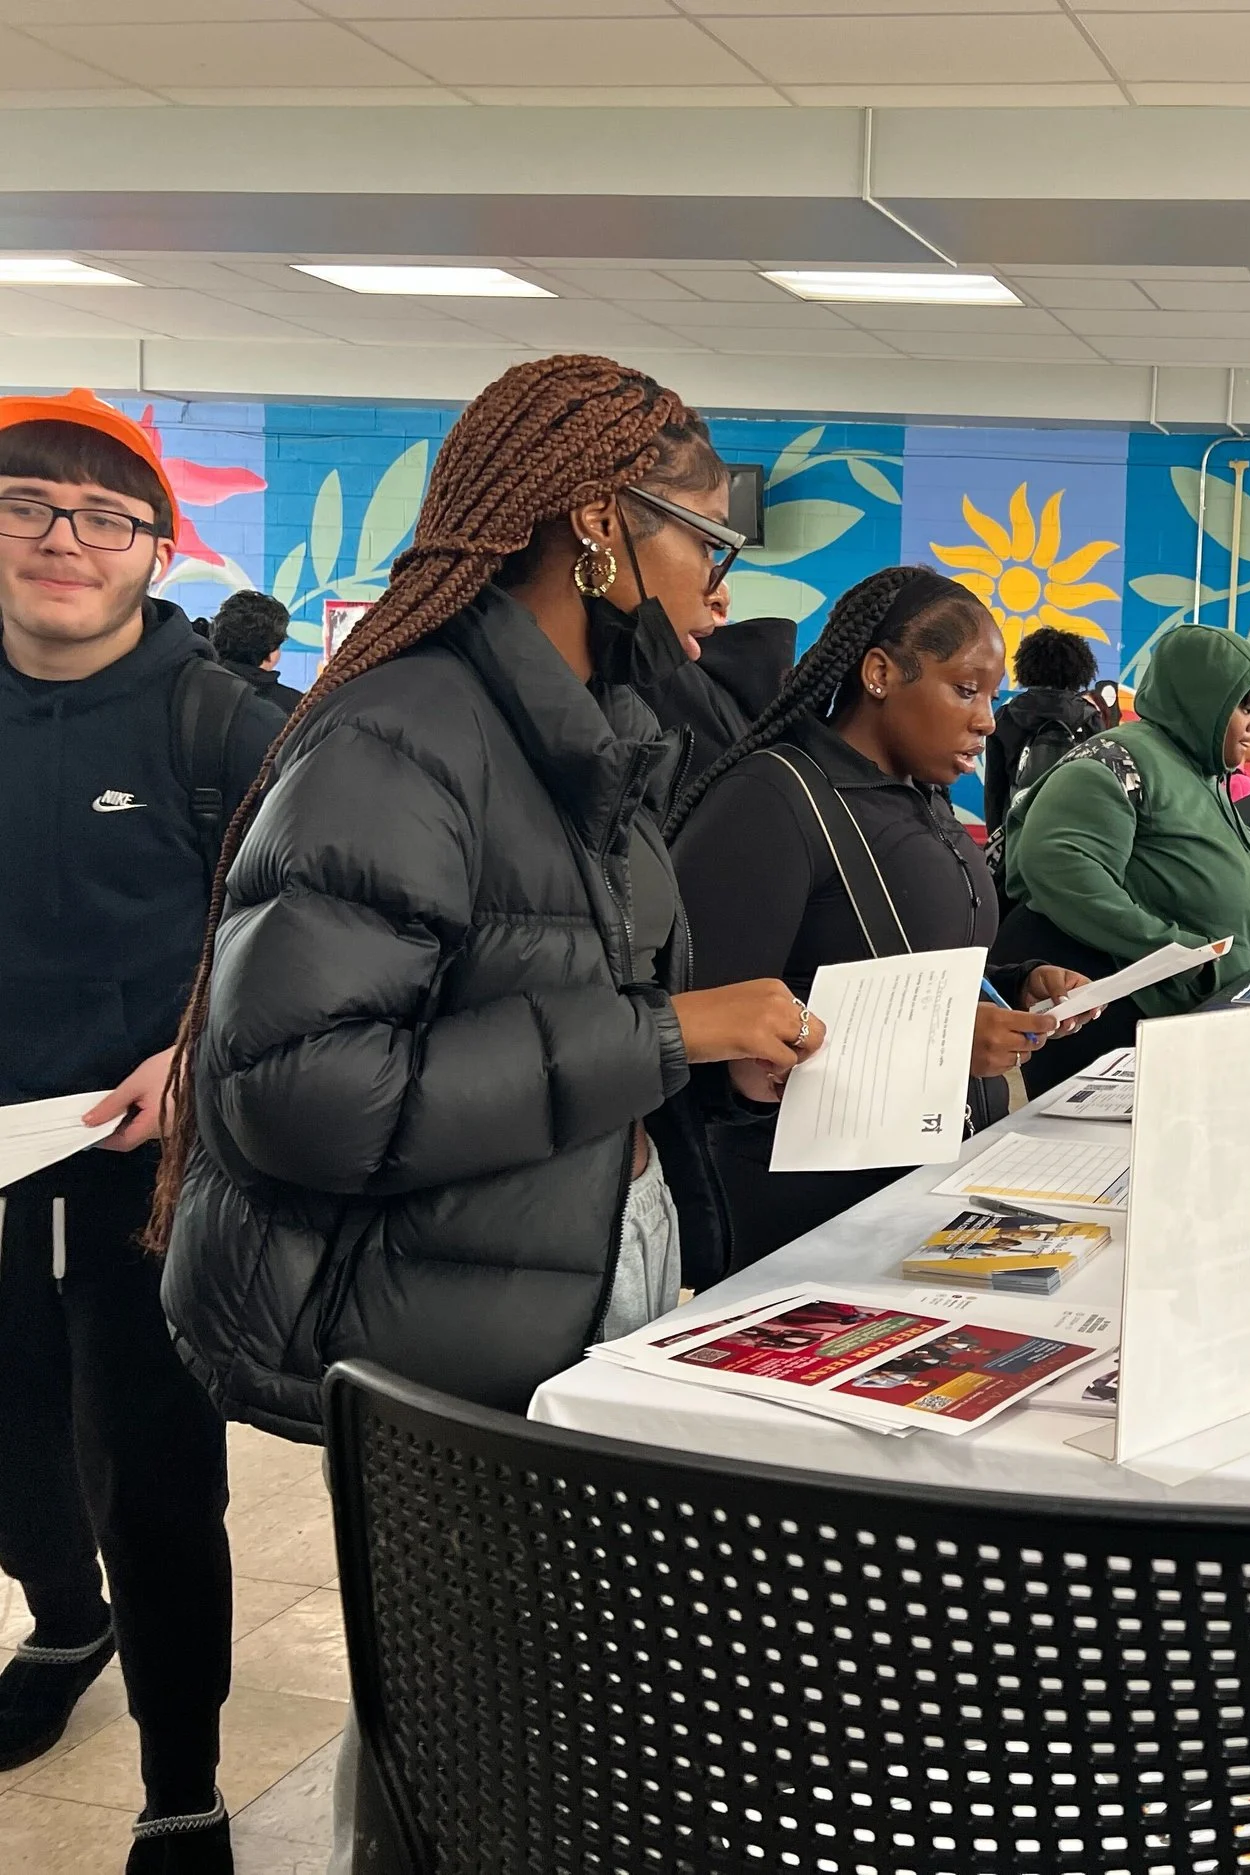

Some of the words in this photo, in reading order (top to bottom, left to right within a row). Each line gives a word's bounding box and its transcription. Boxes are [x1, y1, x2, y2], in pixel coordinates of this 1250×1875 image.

[101, 790, 135, 806] NIKE
[888, 1323, 935, 1344] FREE
[854, 1341, 892, 1360] FOR
[800, 1356, 857, 1382] TEENS
